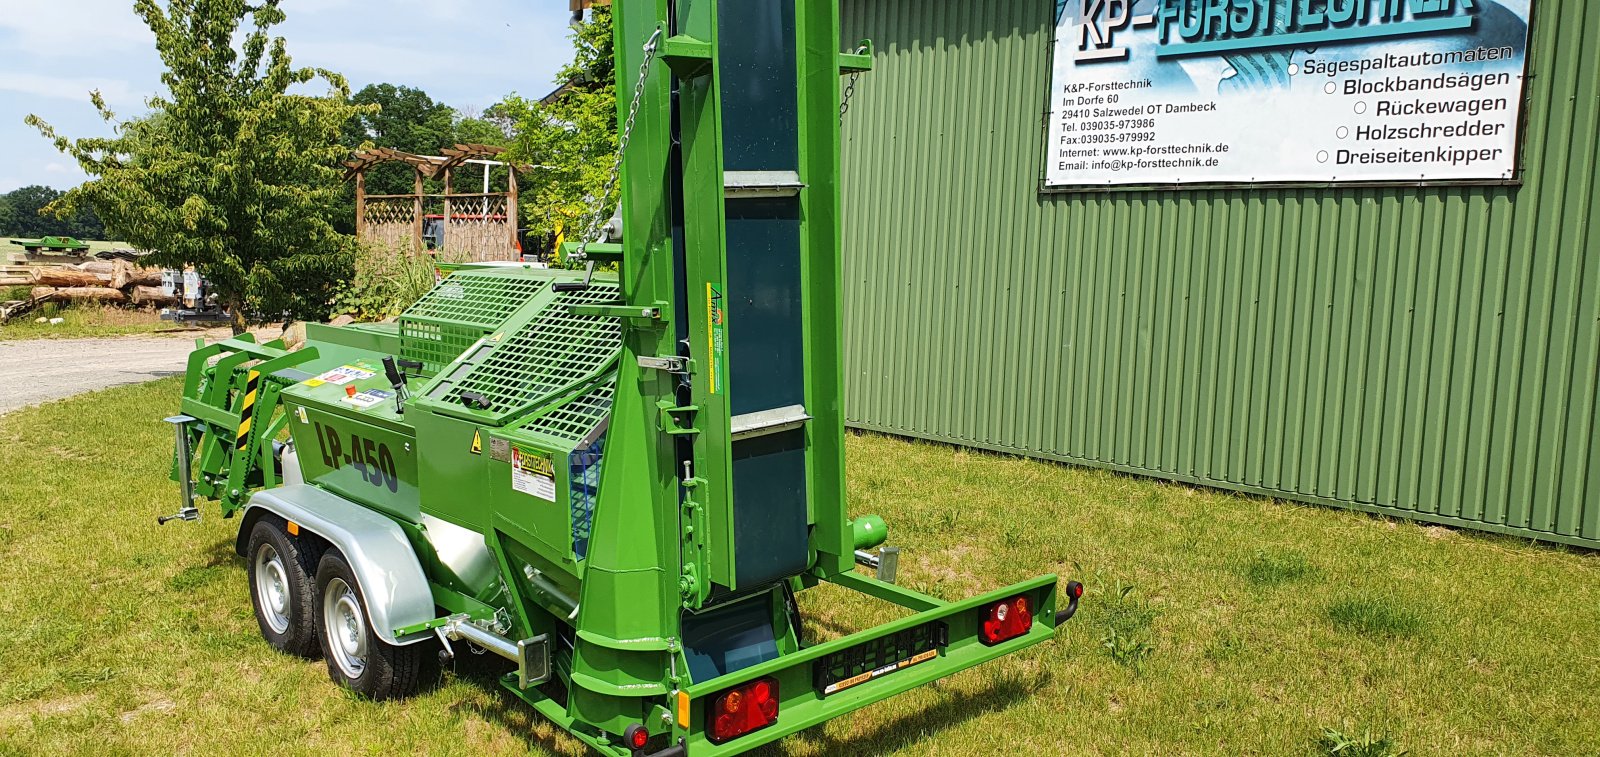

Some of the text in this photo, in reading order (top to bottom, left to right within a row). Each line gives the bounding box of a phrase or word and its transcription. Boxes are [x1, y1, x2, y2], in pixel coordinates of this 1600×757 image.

[1303, 46, 1513, 77] Sägespaltautomaten
[1063, 79, 1153, 94] K&P-Forsttechnik
[1344, 72, 1510, 95] Blockbandsägen
[1062, 94, 1119, 107] Im Dorfe 60
[1376, 97, 1507, 117] Rückewagen
[1062, 101, 1217, 120] 29410 Salzwedel OT Dambeck
[1061, 118, 1155, 132] Tel. 039035-973986
[1355, 120, 1505, 141] Holzschredder
[1059, 143, 1229, 158] Internet: www.kp-forsttechnik.de
[1335, 146, 1503, 165] Dreiseitenkipper
[1058, 157, 1219, 172] Email: info@kp-forsttechnik.de
[313, 421, 398, 494] LP-450
